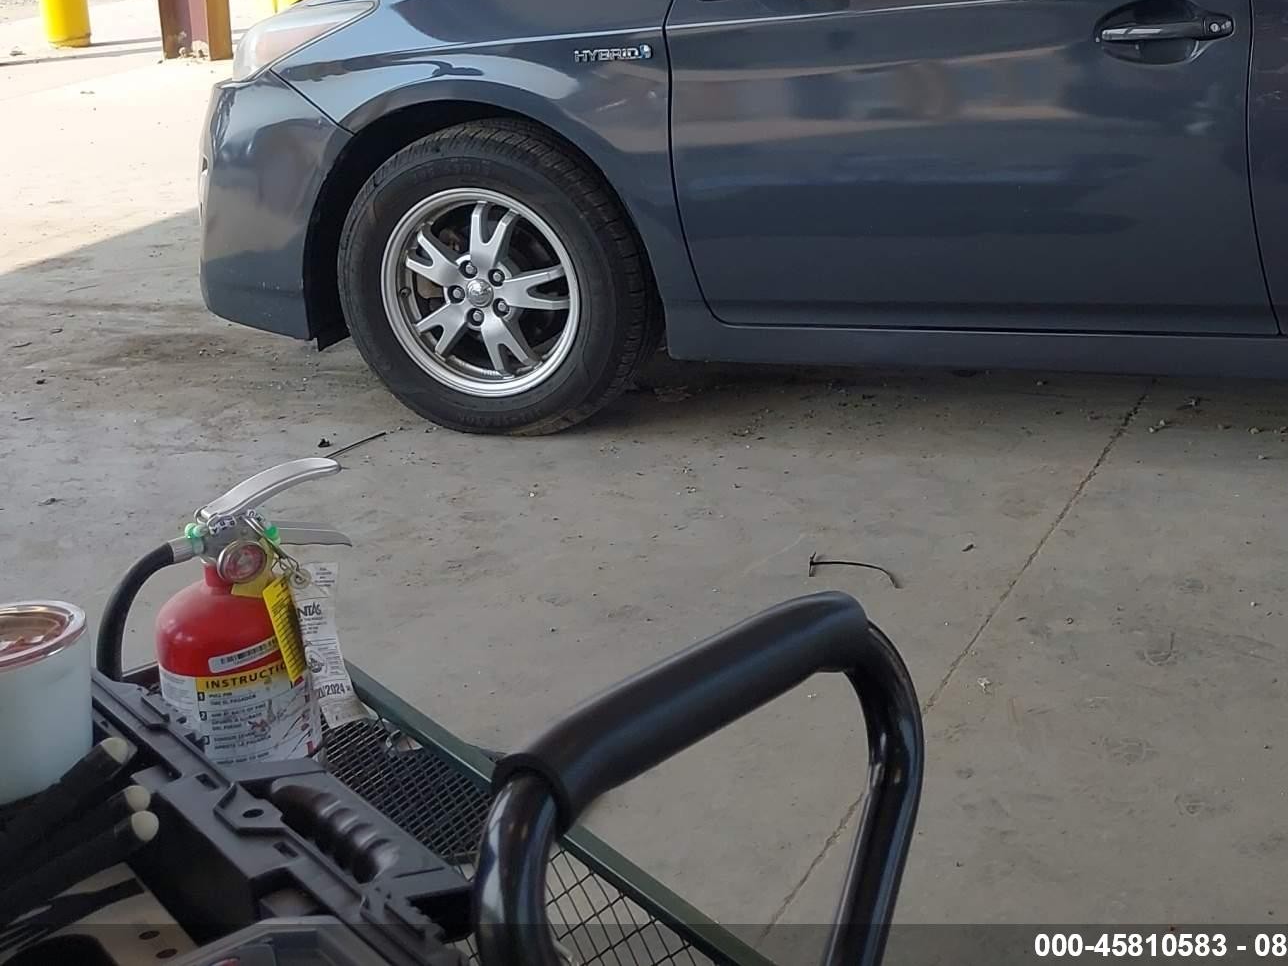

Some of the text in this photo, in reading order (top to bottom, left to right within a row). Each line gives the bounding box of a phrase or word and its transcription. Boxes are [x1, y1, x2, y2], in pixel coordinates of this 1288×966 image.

[574, 47, 640, 63] HYBRID
[297, 602, 322, 619] NTAS
[205, 661, 287, 689] INSTRUCTIO
